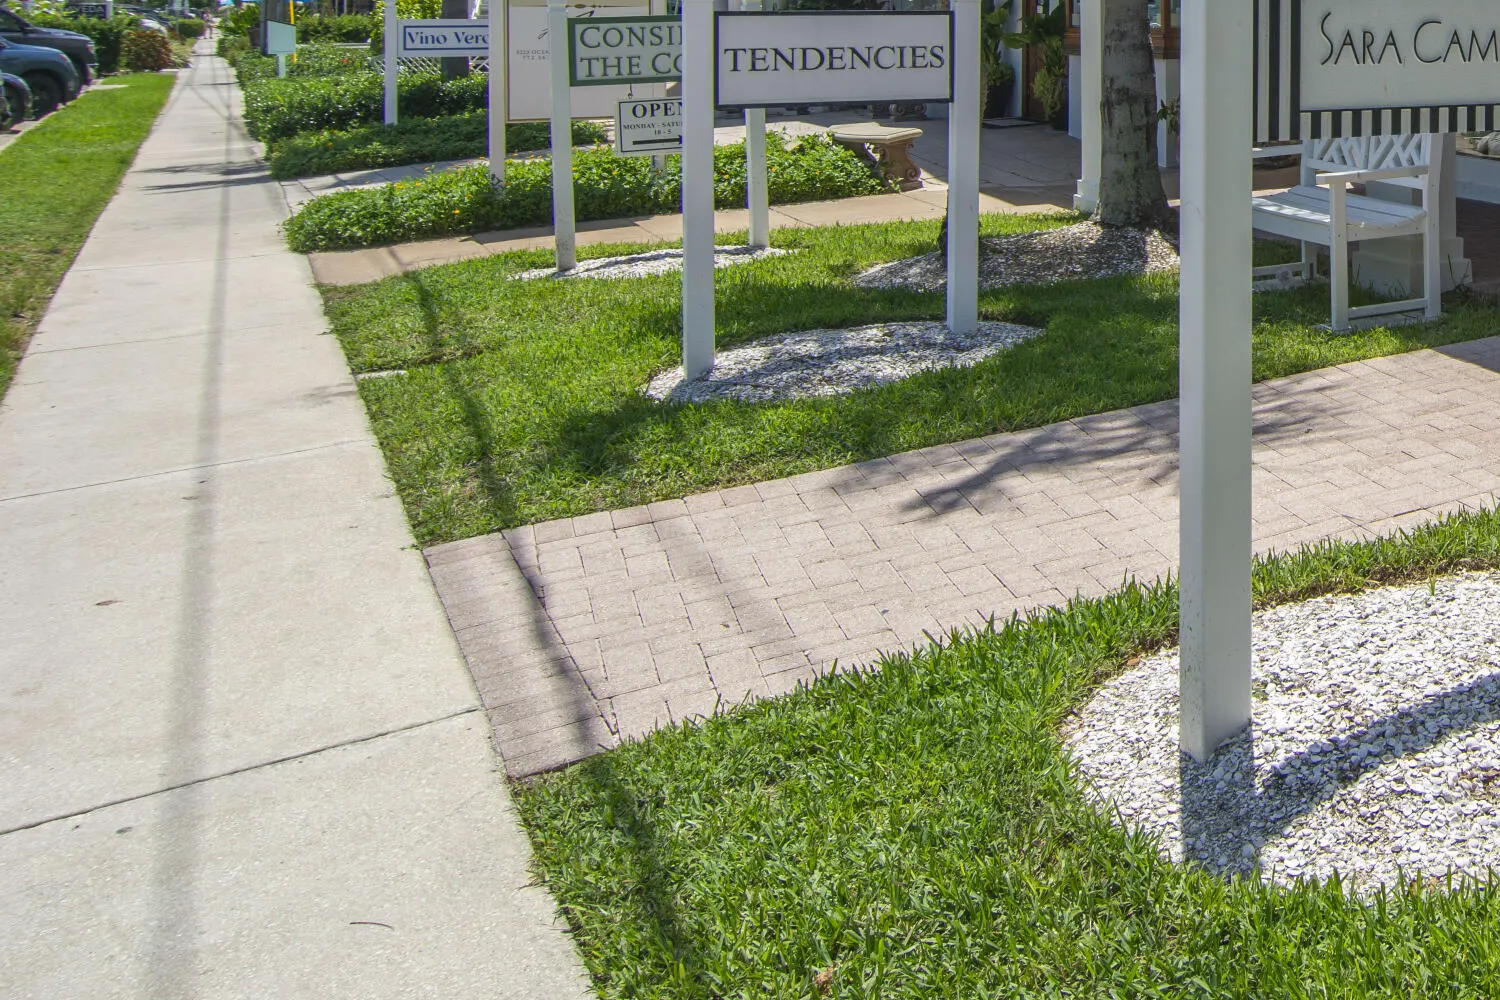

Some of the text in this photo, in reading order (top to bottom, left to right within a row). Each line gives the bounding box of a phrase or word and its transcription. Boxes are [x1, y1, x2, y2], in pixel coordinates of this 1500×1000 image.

[407, 31, 448, 45] Vino
[579, 25, 682, 49] CONSI
[1319, 11, 1403, 67] SARA
[579, 55, 642, 78] THE
[723, 44, 945, 72] TENDENCIES
[623, 121, 656, 130] MONDAY
